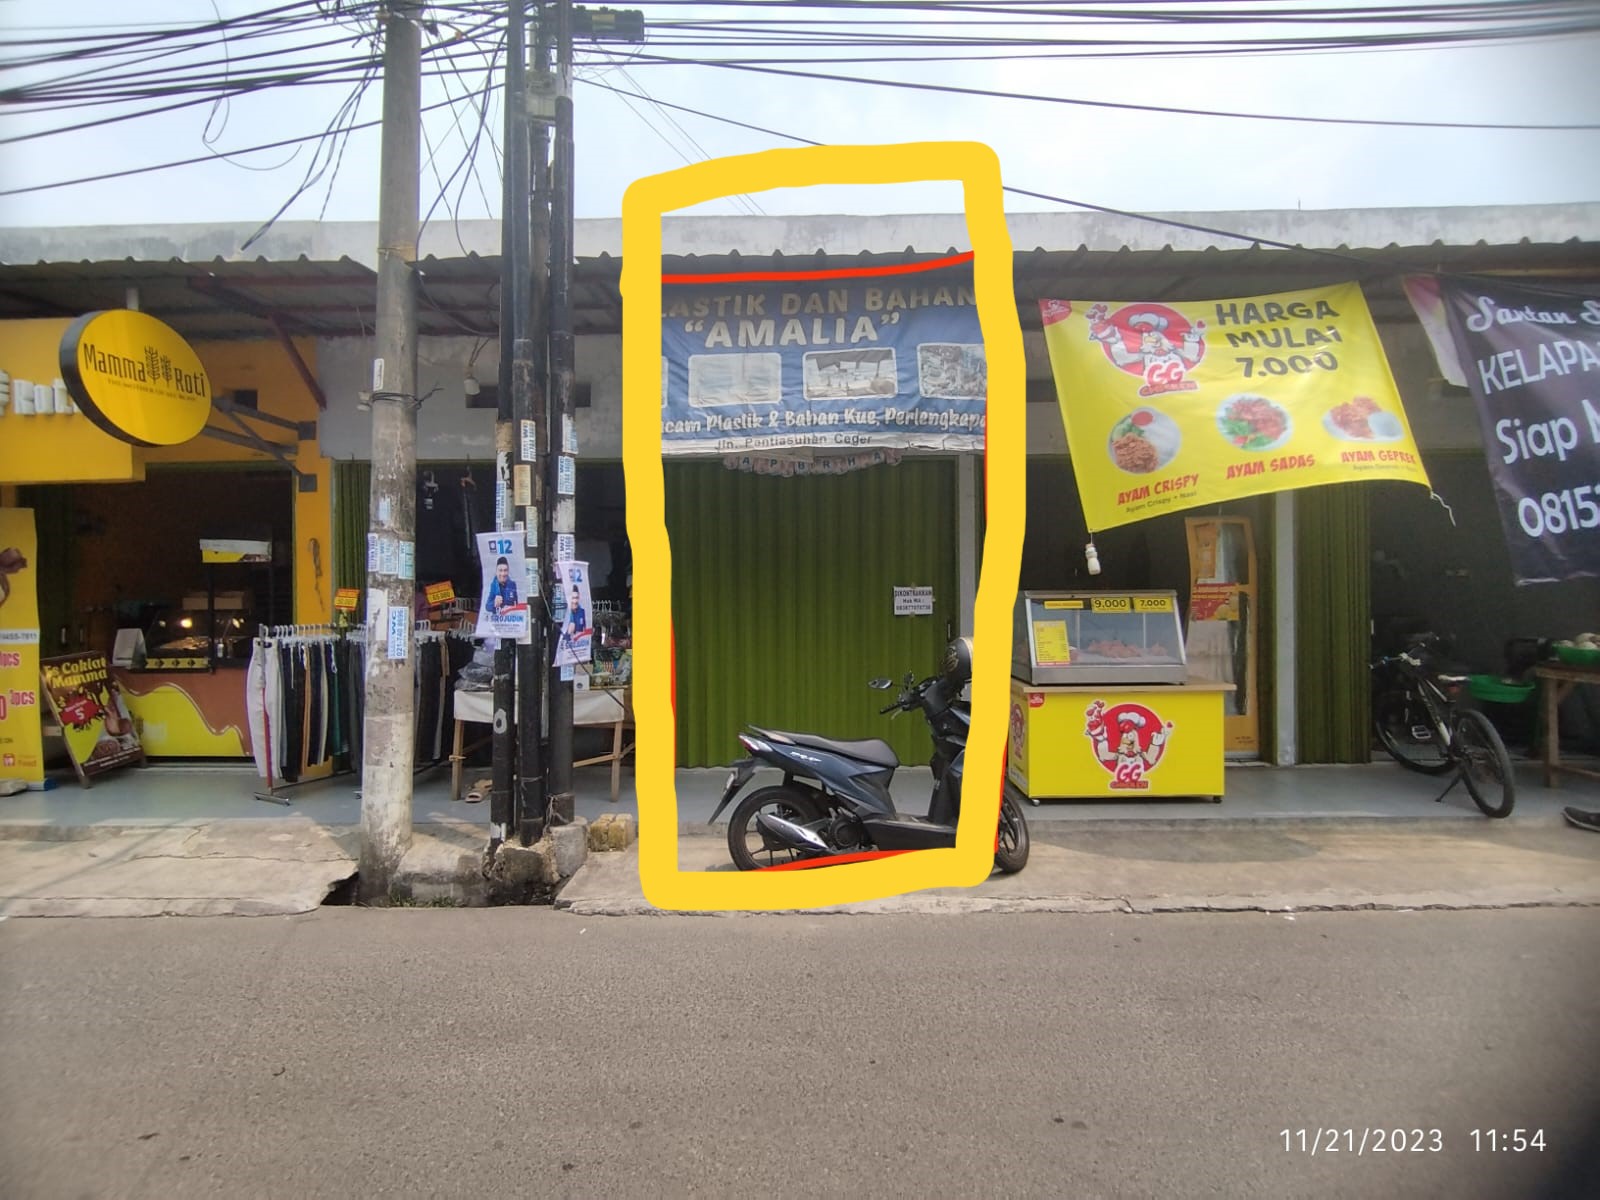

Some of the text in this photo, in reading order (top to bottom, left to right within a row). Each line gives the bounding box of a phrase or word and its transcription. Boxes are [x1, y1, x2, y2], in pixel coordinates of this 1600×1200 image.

[662, 286, 977, 318] ASTIK DAN BAHAN
[1215, 299, 1341, 327] HARGA
[1466, 295, 1577, 333] Santan
[1225, 325, 1344, 350] MULAI
[84, 343, 147, 383] Mamma
[174, 367, 206, 398] Roti
[1147, 361, 1184, 386] GG
[1235, 350, 1340, 379] 7.000
[706, 408, 764, 432] Plastik
[768, 410, 780, 427] &
[785, 409, 839, 428] Bahan
[834, 433, 873, 447] Ceger
[1496, 411, 1579, 465] Siap
[1225, 453, 1316, 480] AYAM SADAS
[1341, 450, 1375, 463] AYAM
[1117, 473, 1199, 506] AYAM CRISPY
[1517, 485, 1600, 538] 0815
[497, 539, 513, 555] 12
[1093, 599, 1127, 609] 9.000
[1139, 598, 1167, 607] 7.000
[391, 610, 397, 635] WC
[62, 656, 107, 675] Coklat
[52, 669, 108, 689] Mamma
[1116, 763, 1142, 783] GG
